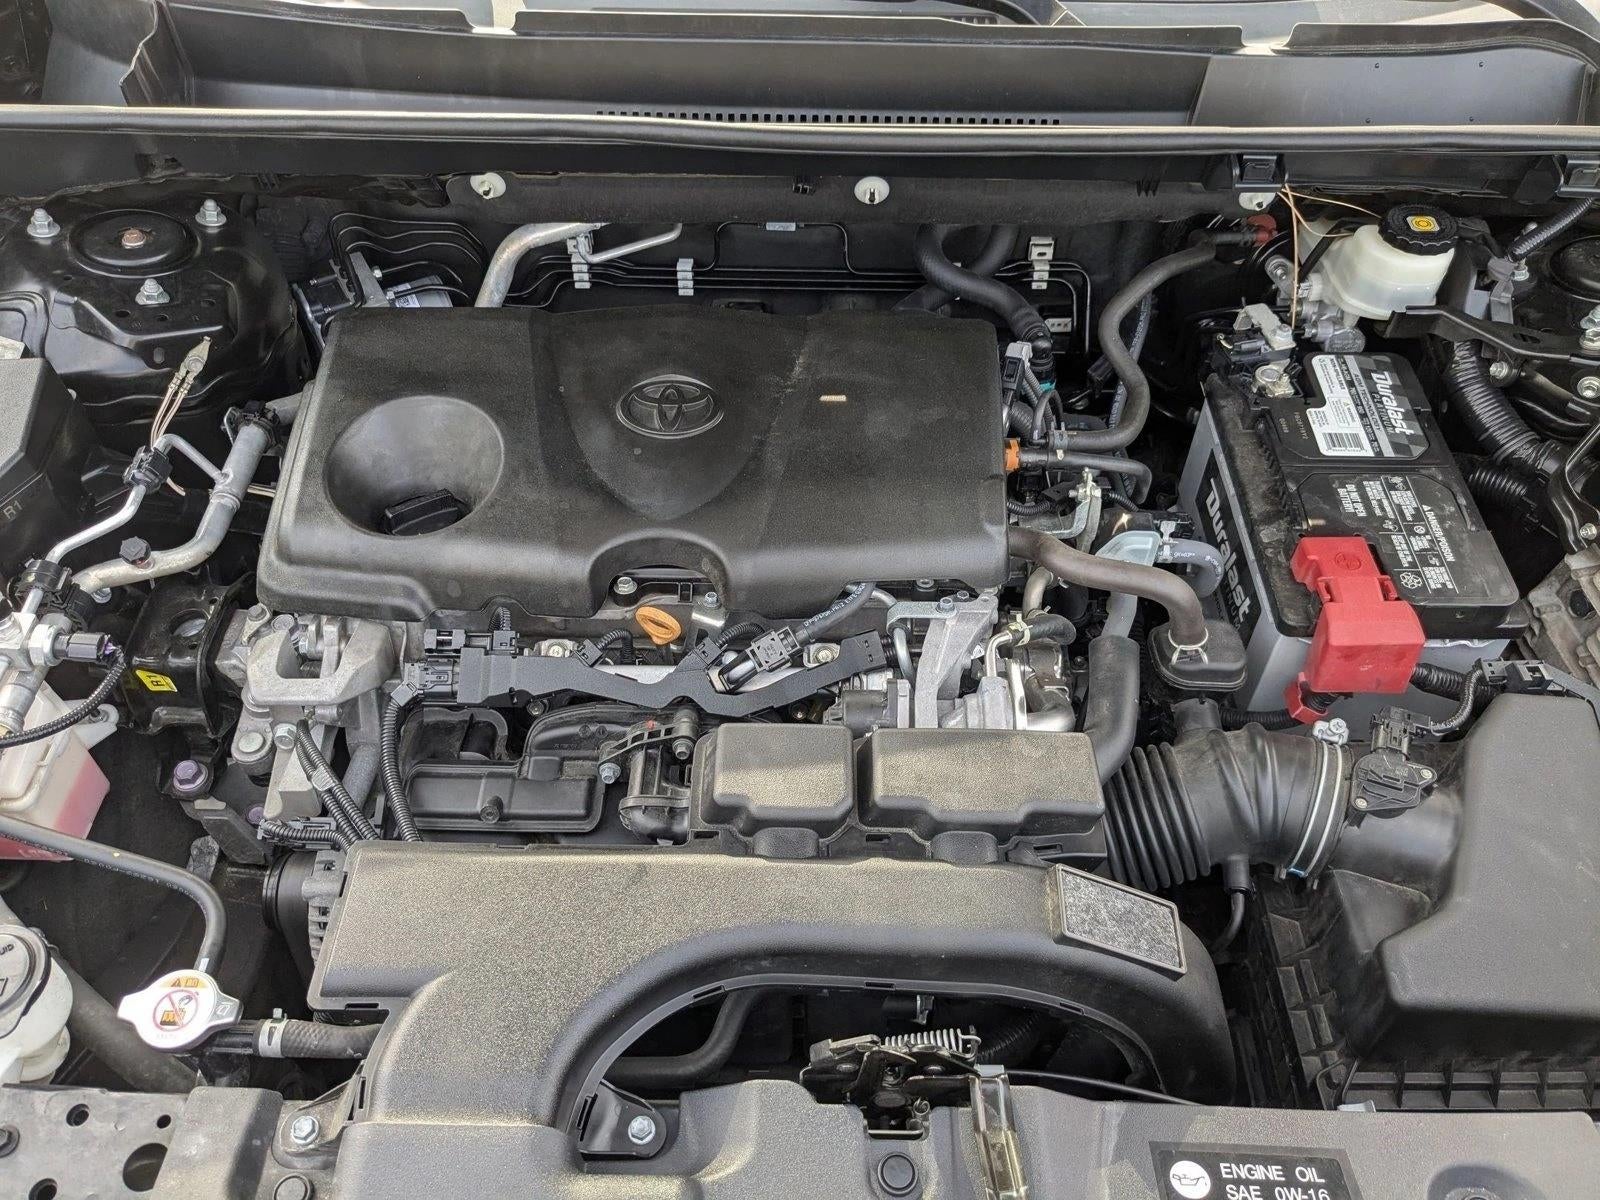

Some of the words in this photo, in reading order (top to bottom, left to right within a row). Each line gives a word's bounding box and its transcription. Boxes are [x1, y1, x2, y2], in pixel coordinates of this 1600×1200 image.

[1371, 371, 1415, 435] Duralast
[1205, 478, 1250, 622] Duralast
[1219, 1162, 1285, 1181] ENGINE
[1294, 1166, 1326, 1183] OIL
[1225, 1184, 1264, 1200] SAE
